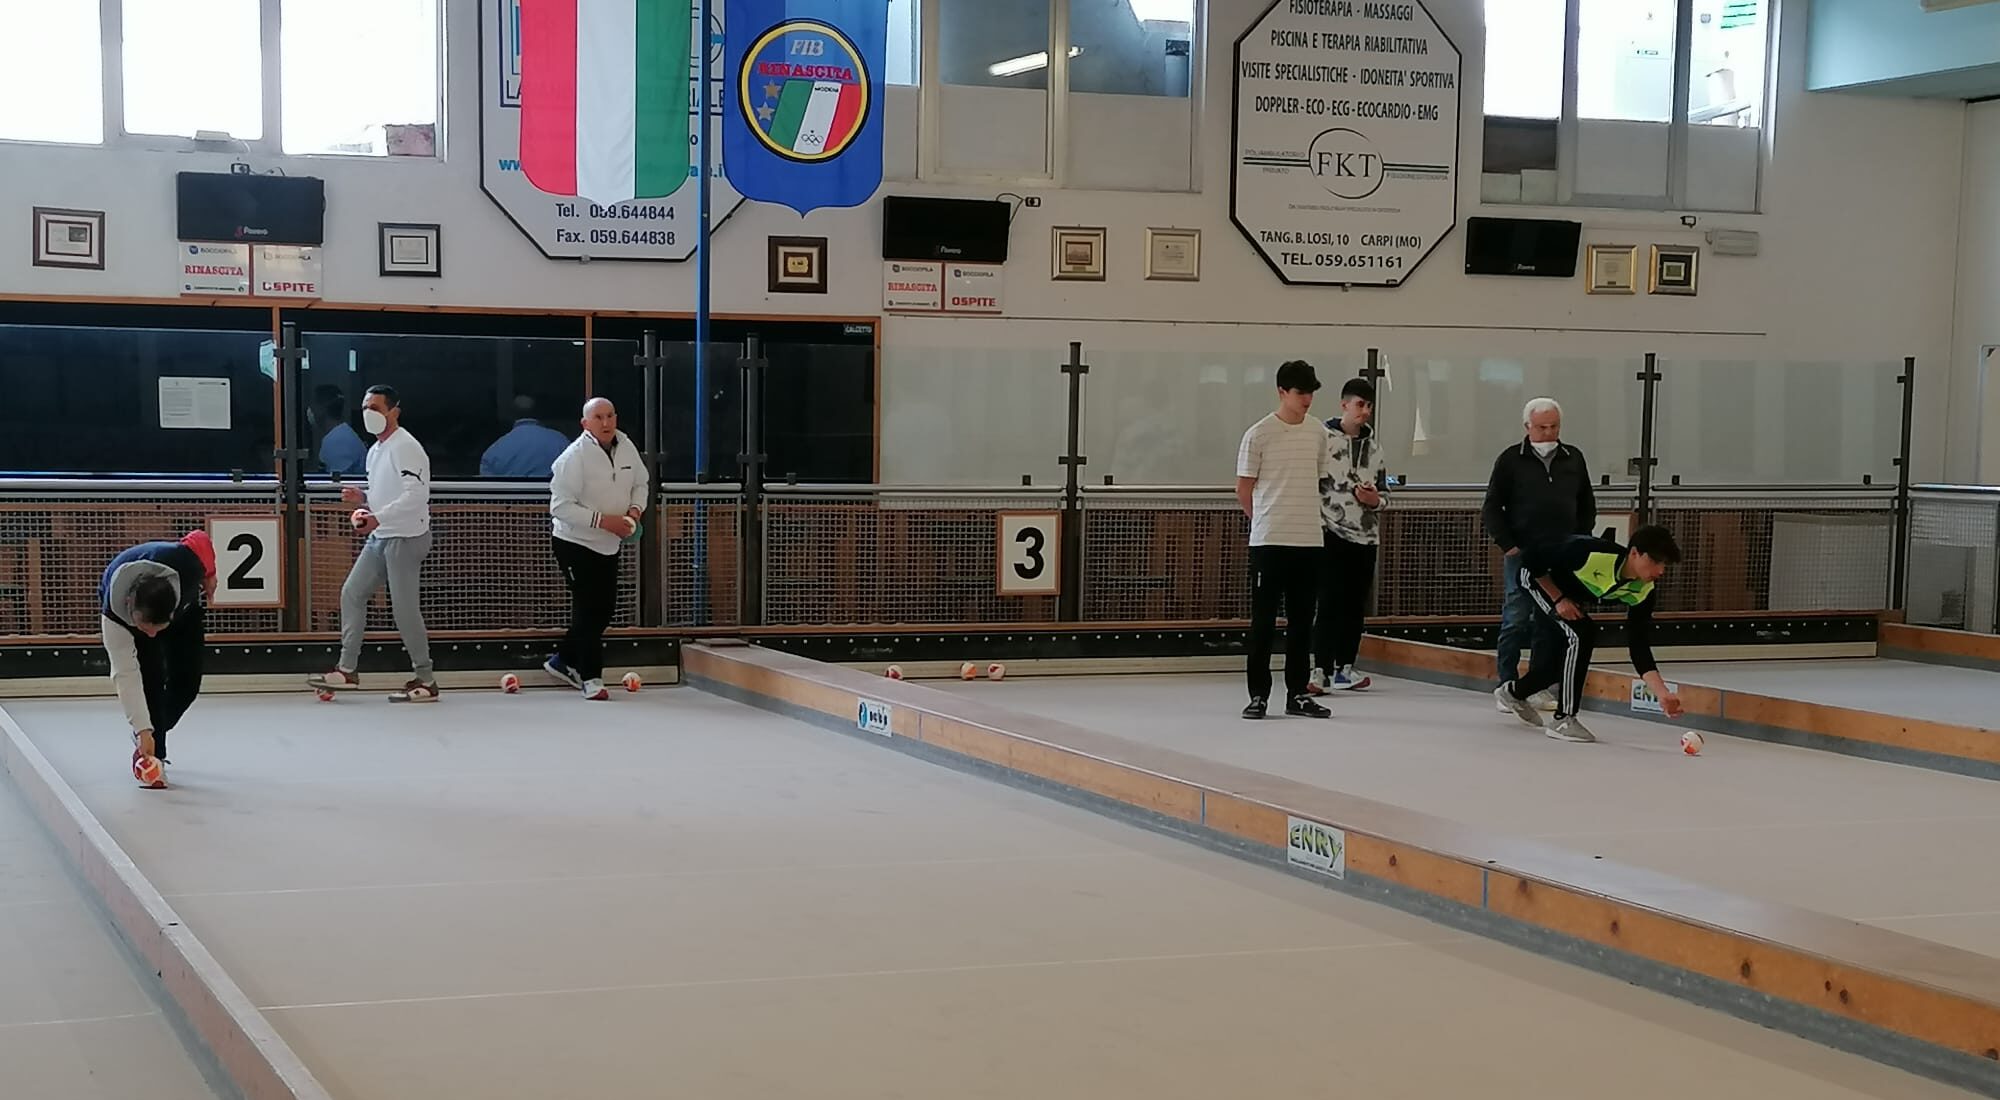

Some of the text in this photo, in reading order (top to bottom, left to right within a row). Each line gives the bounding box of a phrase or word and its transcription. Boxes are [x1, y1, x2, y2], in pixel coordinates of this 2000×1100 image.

[1290, 0, 1352, 17] FISIOTERAPIA
[1364, 3, 1413, 21] MASSAGGI
[790, 39, 824, 56] FIB
[1271, 30, 1428, 55] PISCINA E TERAPIA RIABILITATIVA
[758, 62, 853, 80] RINASCITA
[1242, 61, 1271, 79] VISITE
[1275, 62, 1348, 83] SPECIALISTICHE
[1361, 68, 1407, 87] IDONEITA'
[1410, 70, 1454, 89] SPORTIVA
[1255, 96, 1299, 114] DOPPLER
[1306, 99, 1324, 115] ECO
[1332, 100, 1350, 116] ECG
[1357, 101, 1411, 119] ECOCARDIO
[1418, 104, 1438, 121] EMG
[1316, 152, 1376, 178] FKT
[555, 203, 580, 218] Tel.
[557, 229, 676, 245] Fax. 059.644838
[1260, 231, 1421, 248] TANG. B. LOSI, 10 CARPI (MO)
[1281, 252, 1402, 268] TEL. 059.651161
[184, 265, 244, 276] RINASCITA
[887, 282, 937, 292] RINASCITA
[951, 296, 997, 307] OSPITE
[227, 533, 264, 589] 2
[1013, 527, 1045, 579] 3
[1290, 824, 1342, 868] ENRY
